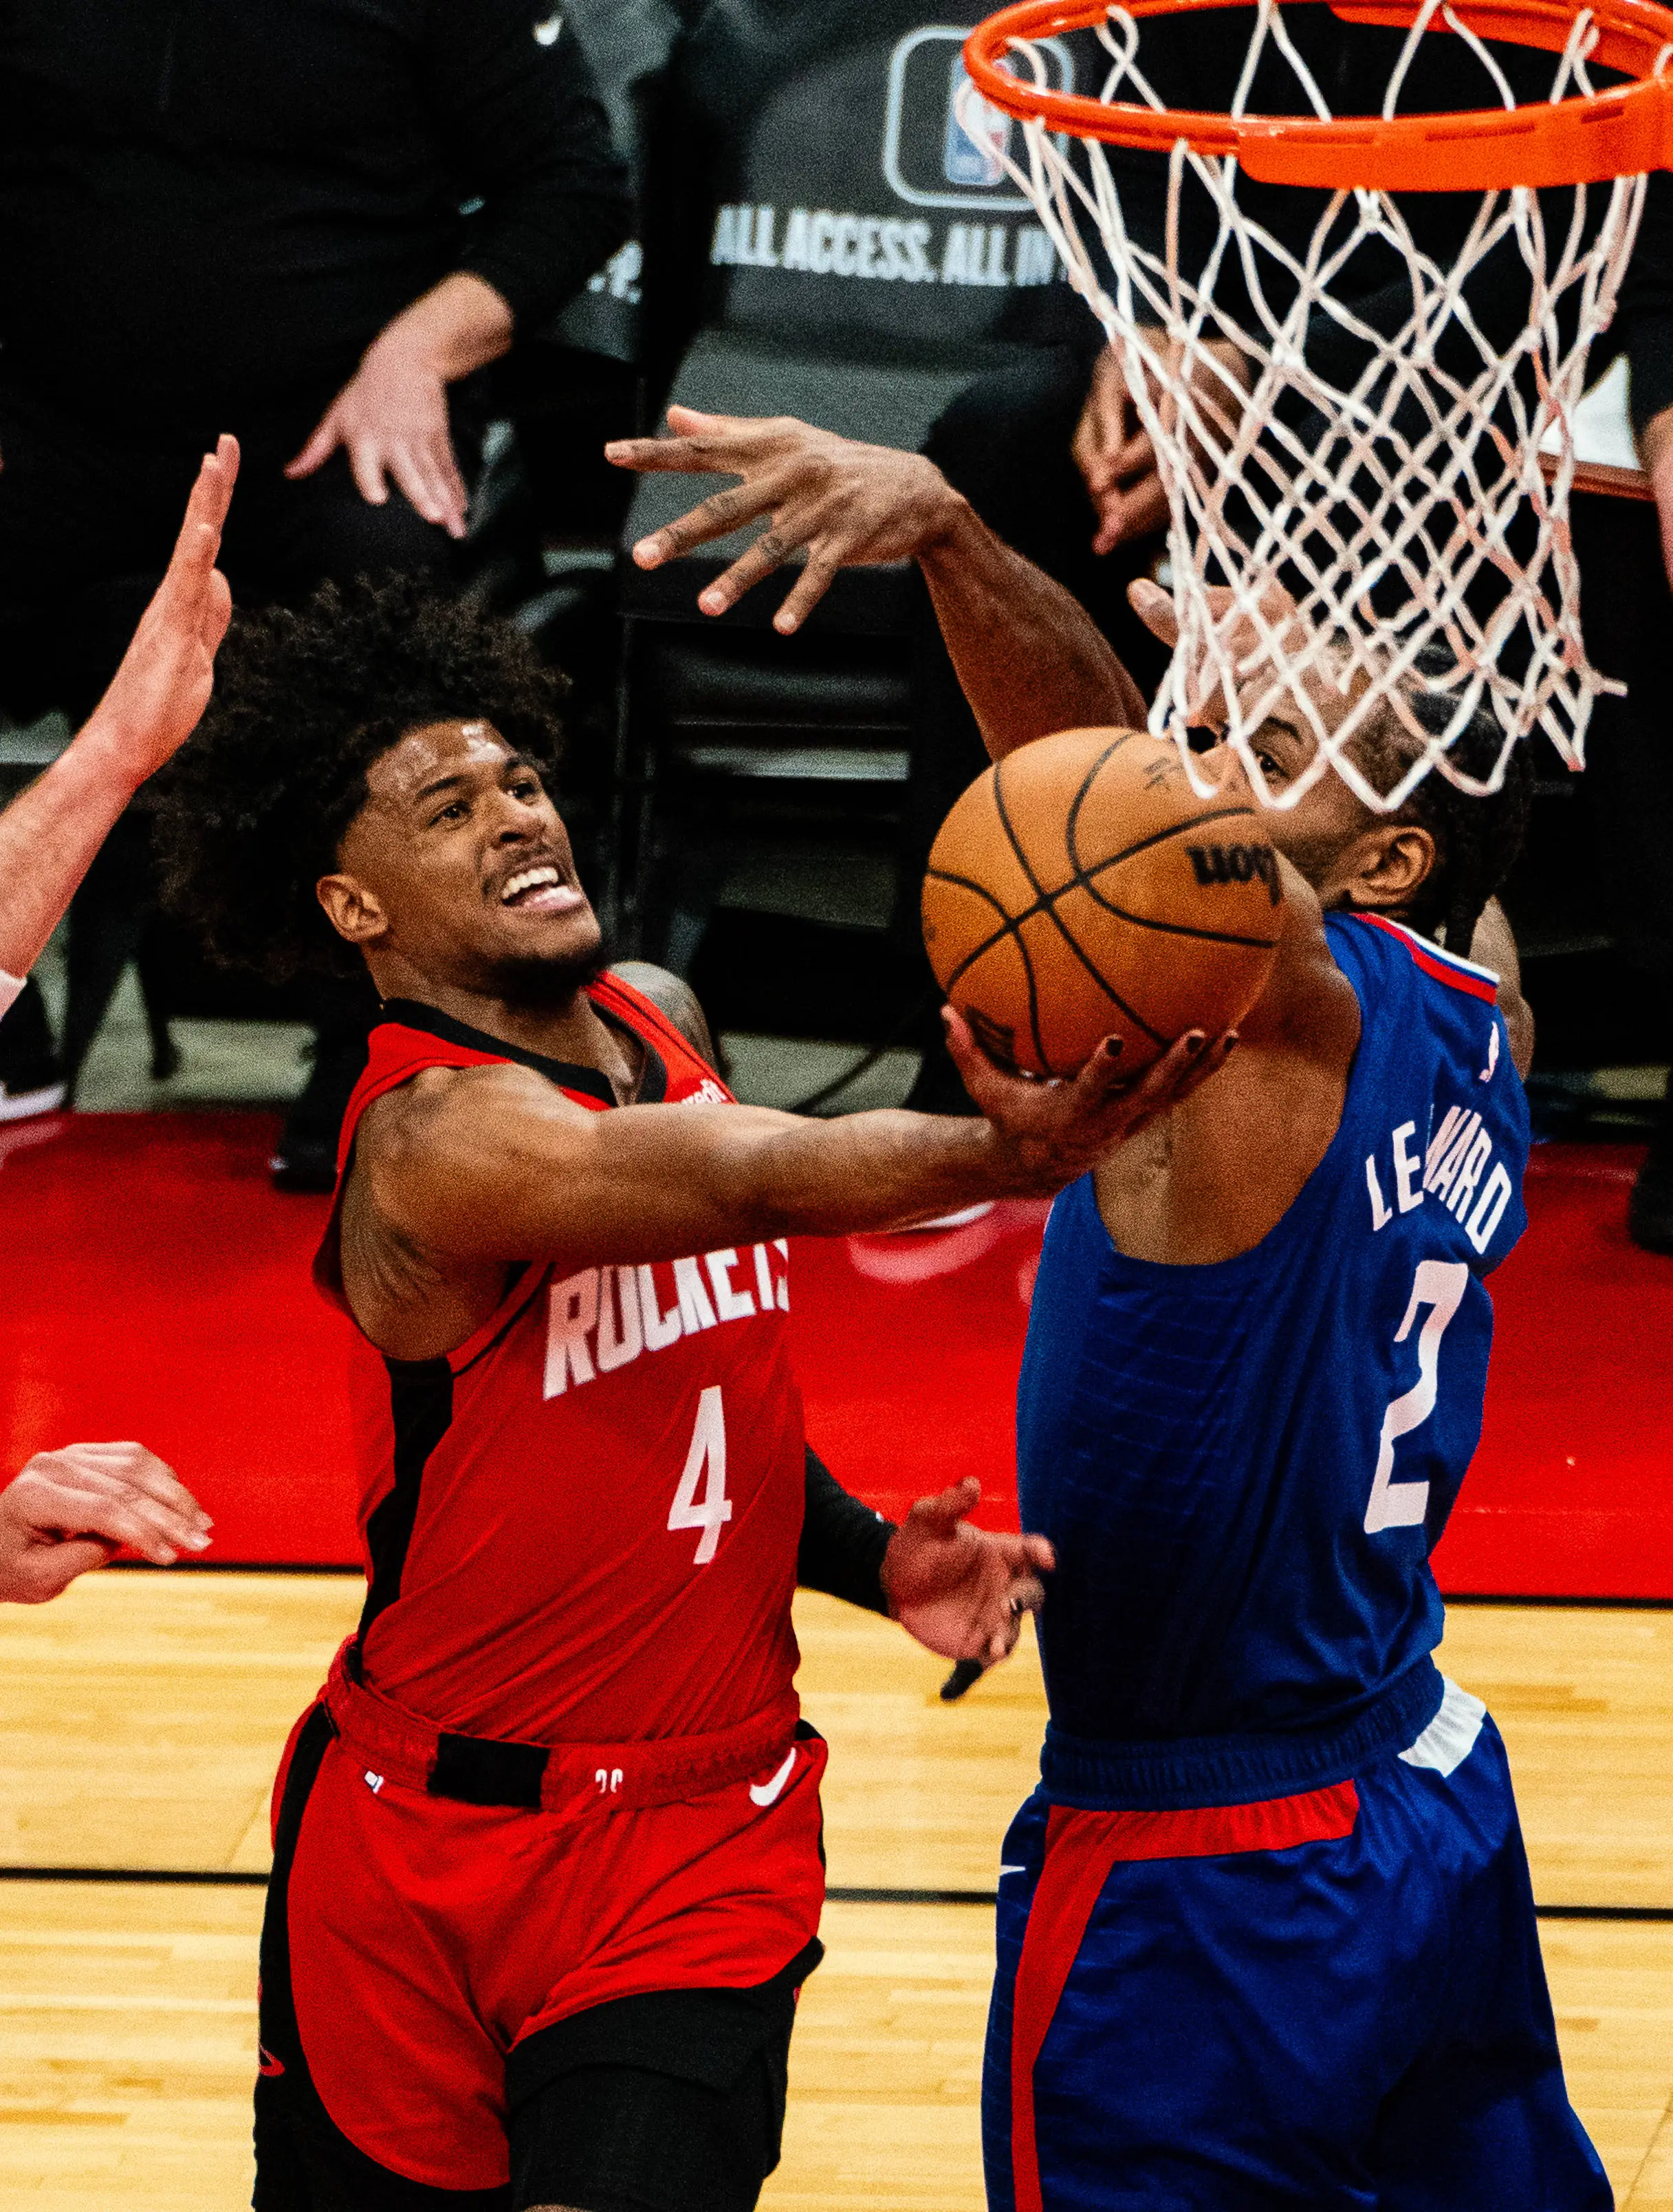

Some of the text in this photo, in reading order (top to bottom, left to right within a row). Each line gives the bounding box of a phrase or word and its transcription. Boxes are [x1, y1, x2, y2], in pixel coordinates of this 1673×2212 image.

[711, 204, 778, 265] ALL
[942, 224, 1009, 286] ALL
[1366, 1105, 1512, 1255] LENARD
[668, 1385, 732, 1565] 4
[1364, 1259, 1468, 1534] 2
